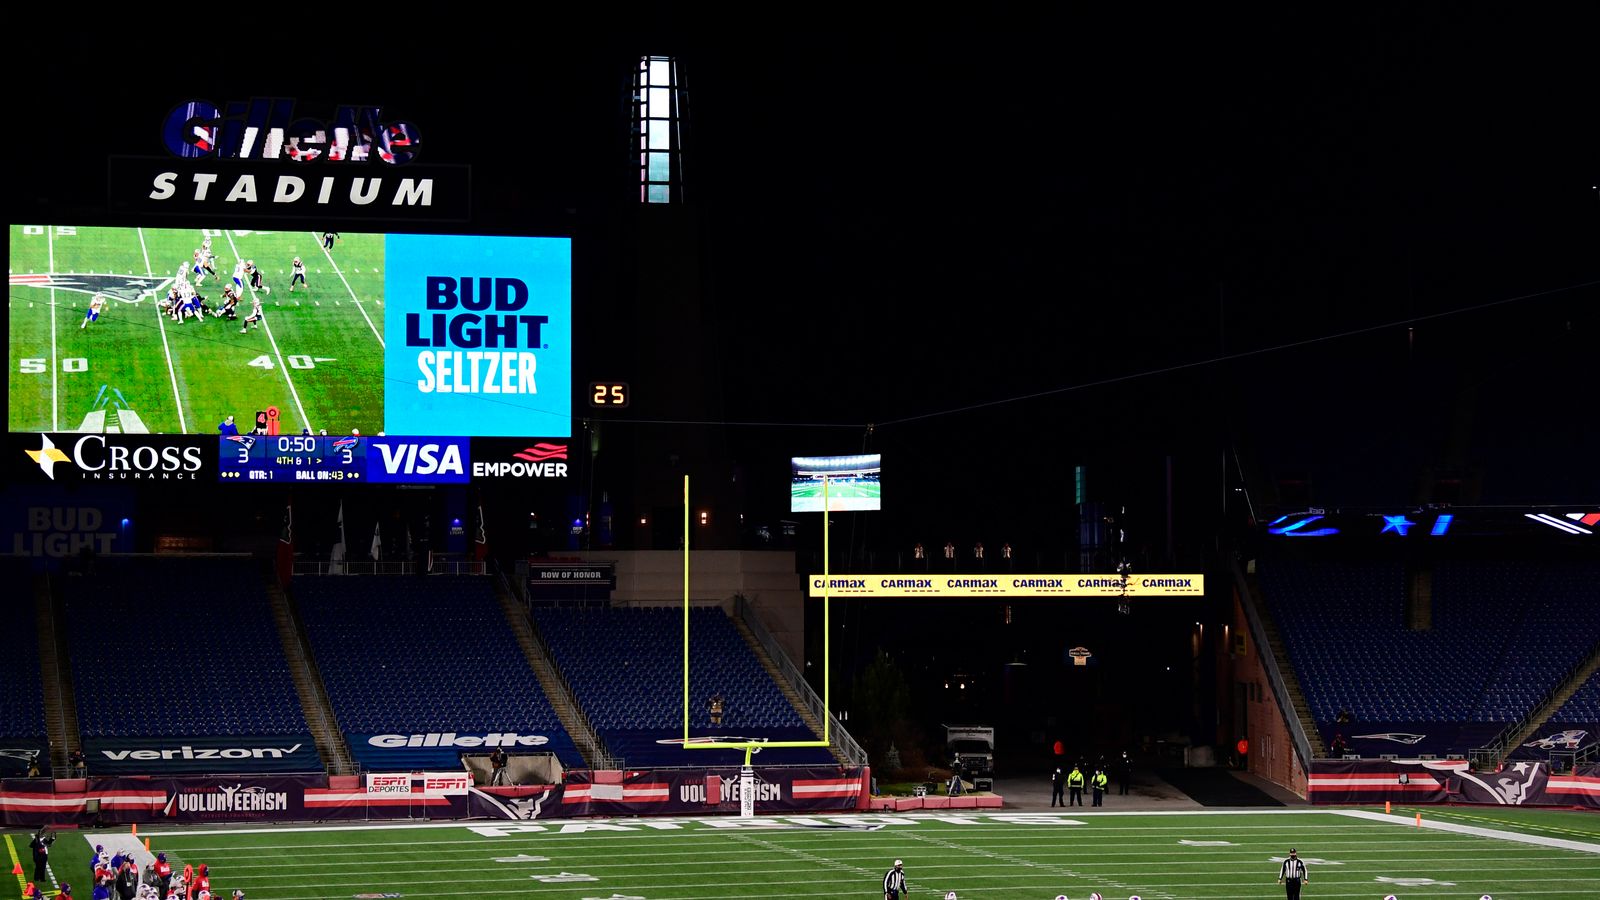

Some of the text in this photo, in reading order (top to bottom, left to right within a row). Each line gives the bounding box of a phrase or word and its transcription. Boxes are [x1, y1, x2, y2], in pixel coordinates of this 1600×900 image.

[161, 97, 423, 165] Gillette
[148, 171, 434, 207] STADIUM
[426, 275, 529, 311] BUD
[406, 312, 549, 349] LIGHT
[417, 350, 538, 394] SELTZER
[594, 385, 624, 404] 25
[278, 437, 316, 452] 0:50
[73, 435, 202, 471] CROSS
[238, 448, 249, 464] 3
[276, 457, 294, 465] 4TH
[342, 449, 353, 464] 3
[373, 444, 464, 474] VISA
[82, 472, 197, 480] INSURANCE
[295, 471, 316, 480] BALL
[473, 462, 568, 478] EMPOWER
[27, 507, 104, 531] BUD
[13, 532, 117, 558] LIGHT
[541, 571, 602, 579] ROW OF HONOR
[368, 733, 549, 748] Gillette
[101, 746, 281, 760] verizon
[373, 776, 407, 786] ESPN
[426, 778, 467, 789] ESPN
[368, 786, 410, 794] DEPORTES
